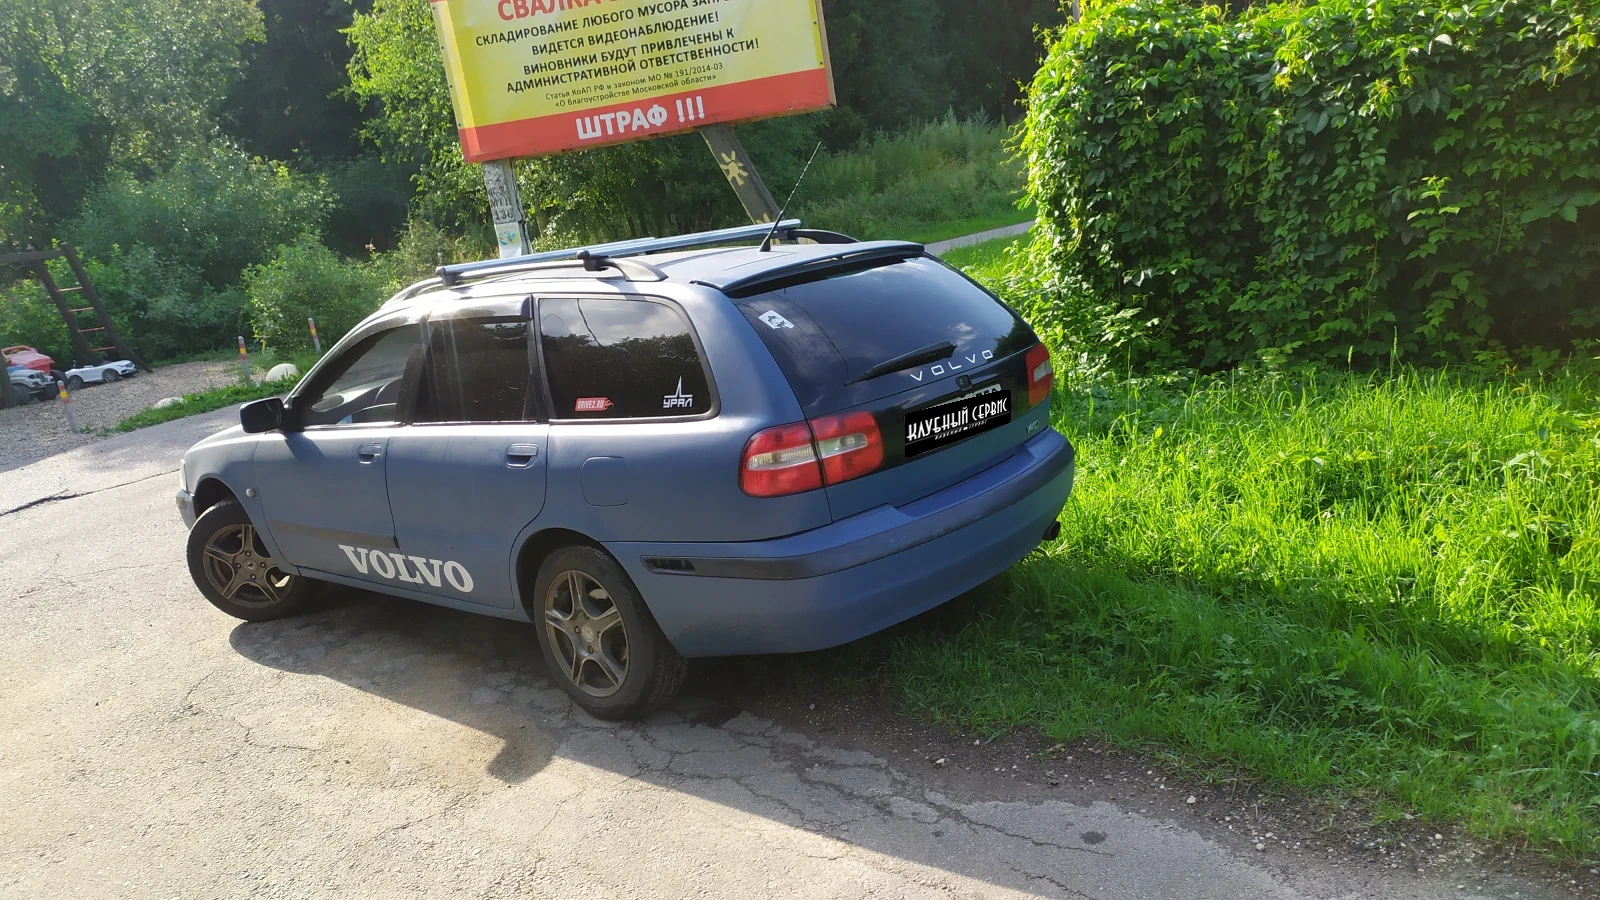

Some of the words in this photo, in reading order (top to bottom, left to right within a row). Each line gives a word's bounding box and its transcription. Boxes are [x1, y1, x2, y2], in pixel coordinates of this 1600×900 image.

[475, 19, 579, 47] СКЛАДИРОВАНИЕ
[582, 9, 635, 29] ЛЮБОГО
[637, 0, 689, 17] МУСОРА
[531, 37, 585, 56] ВИДЕТСЯ
[588, 11, 719, 45] ВИДЕОНАБЛЮДЕНИЕ!
[506, 60, 637, 94] АДМИНИСТРАТИВНОЙ
[639, 37, 760, 70] ОТВЕТСТВЕННОСТИ!
[523, 56, 598, 76] ВИНОВНИКИ
[601, 46, 638, 63] БУДУТ
[641, 29, 724, 55] ПРИВЛЕЧЕНЫ
[726, 28, 735, 39] К
[545, 91, 571, 101] Статья
[571, 86, 592, 97] КоАП
[594, 83, 605, 94] РФ
[614, 79, 648, 89] законом
[648, 73, 662, 83] МО
[663, 71, 673, 80] №
[567, 90, 631, 106] благоустройстве
[631, 79, 679, 95] Московской
[680, 74, 717, 86] области»
[576, 104, 668, 140] ШТРАФ
[675, 95, 705, 123] !!!
[909, 349, 994, 382] VOLVO
[662, 397, 693, 409] УРАЛ
[338, 544, 474, 593] VOLVO
